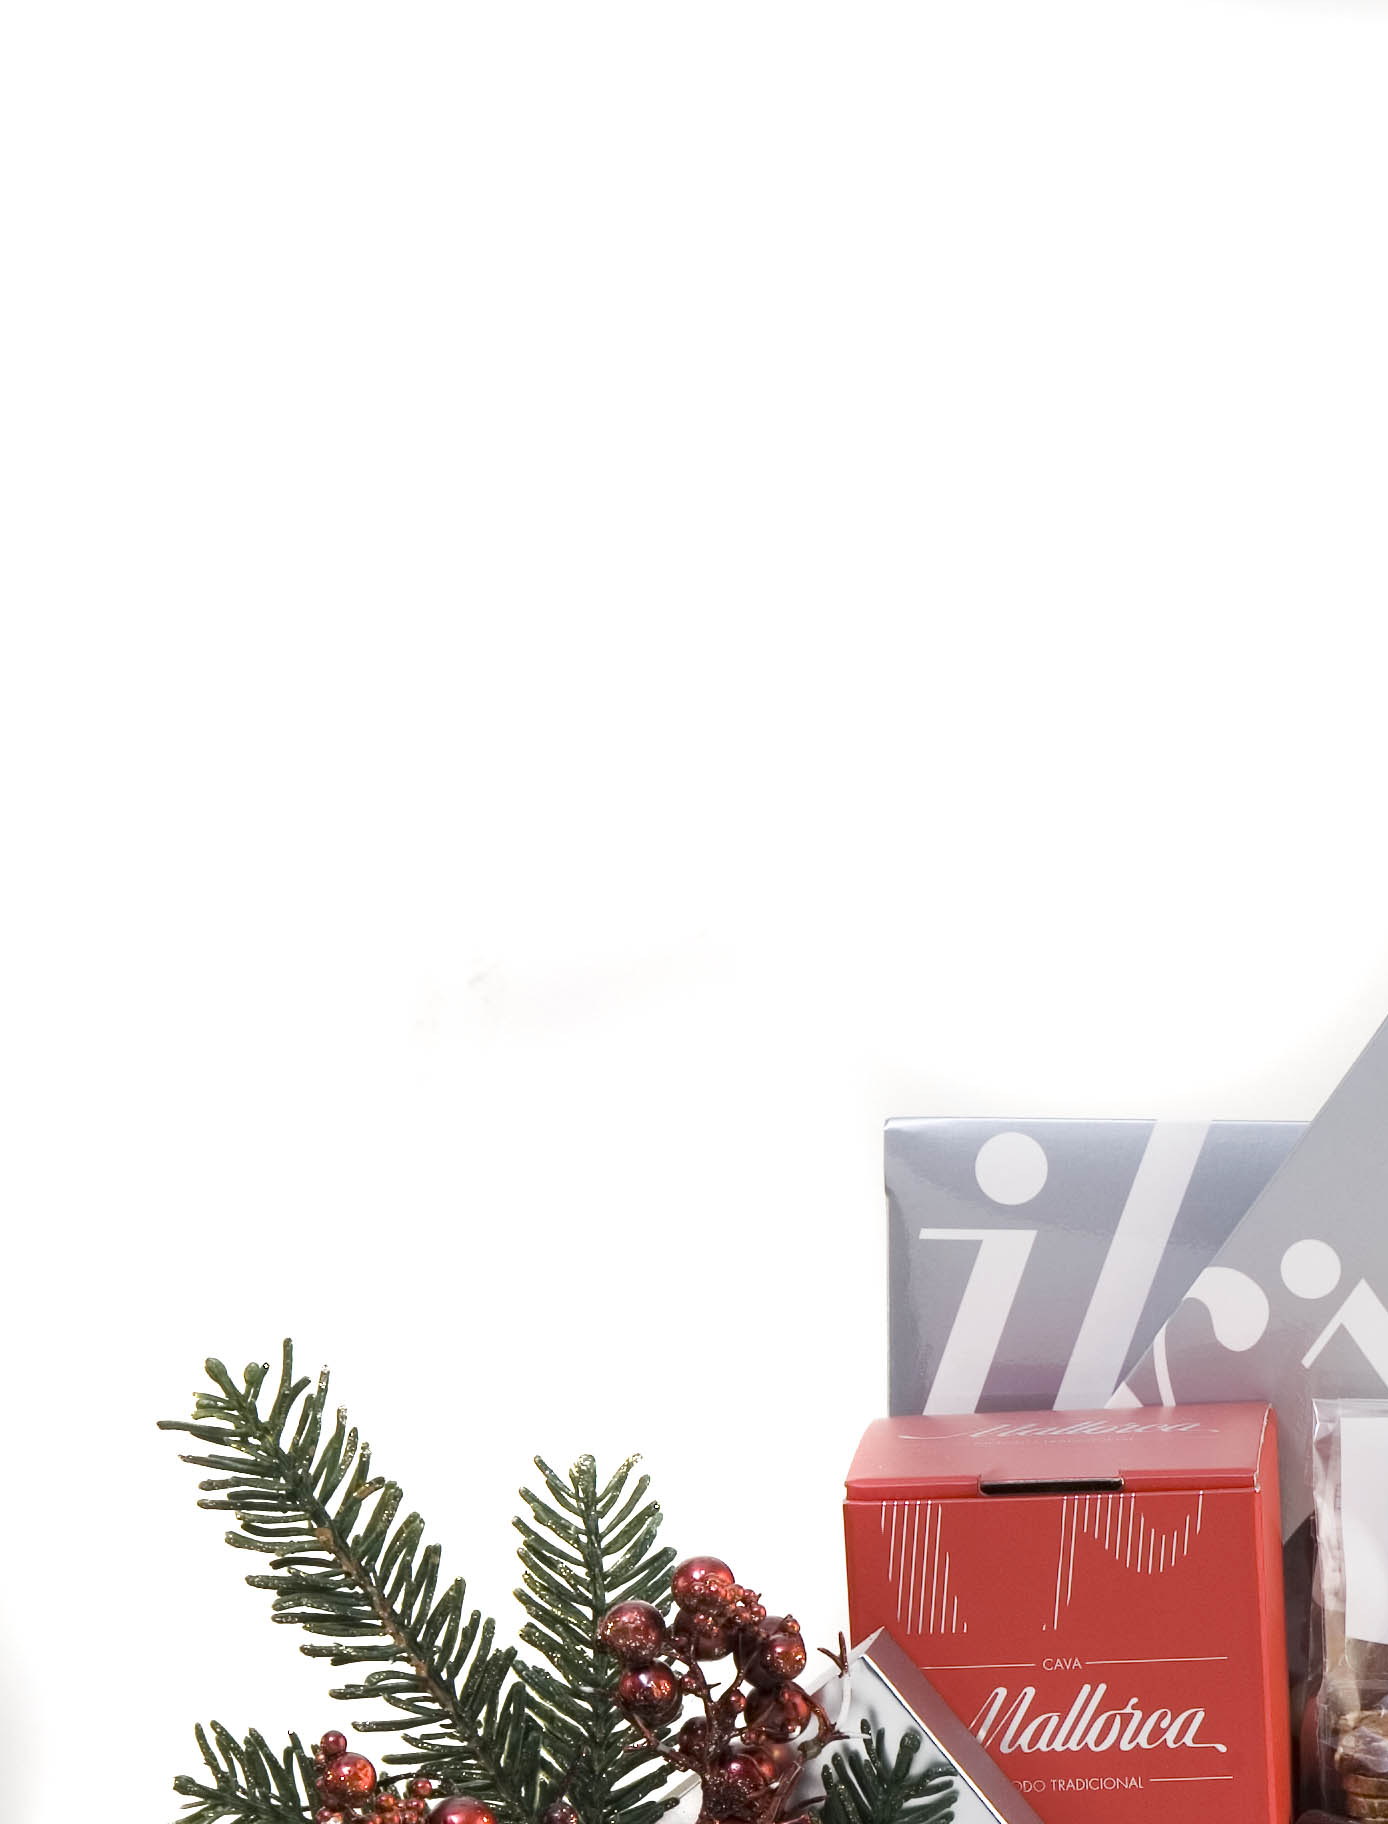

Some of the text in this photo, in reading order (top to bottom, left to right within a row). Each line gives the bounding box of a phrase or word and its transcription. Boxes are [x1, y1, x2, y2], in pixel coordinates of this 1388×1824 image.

[1042, 1657, 1083, 1670] CAVA
[966, 1683, 1228, 1754] Mallorca
[1014, 1776, 1144, 1793] ODO TRADICIONAL
